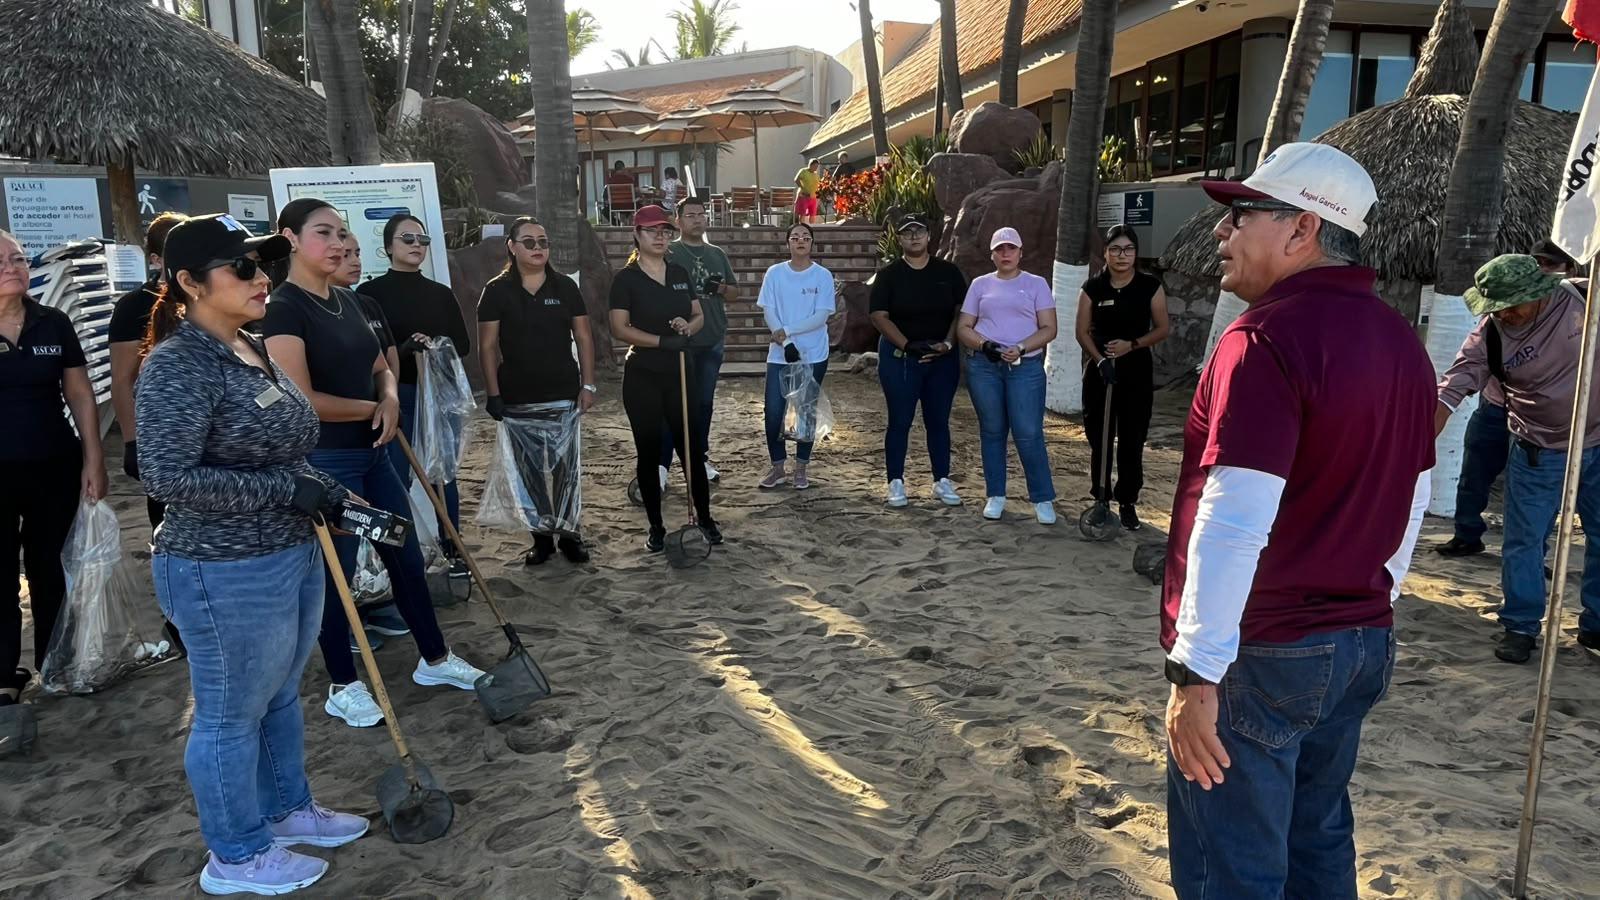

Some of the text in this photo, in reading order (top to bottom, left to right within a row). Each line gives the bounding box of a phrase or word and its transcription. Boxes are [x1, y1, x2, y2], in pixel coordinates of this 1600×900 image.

[1299, 187, 1318, 201] Ángel
[1319, 197, 1340, 212] García
[12, 204, 58, 213] enjuagarse
